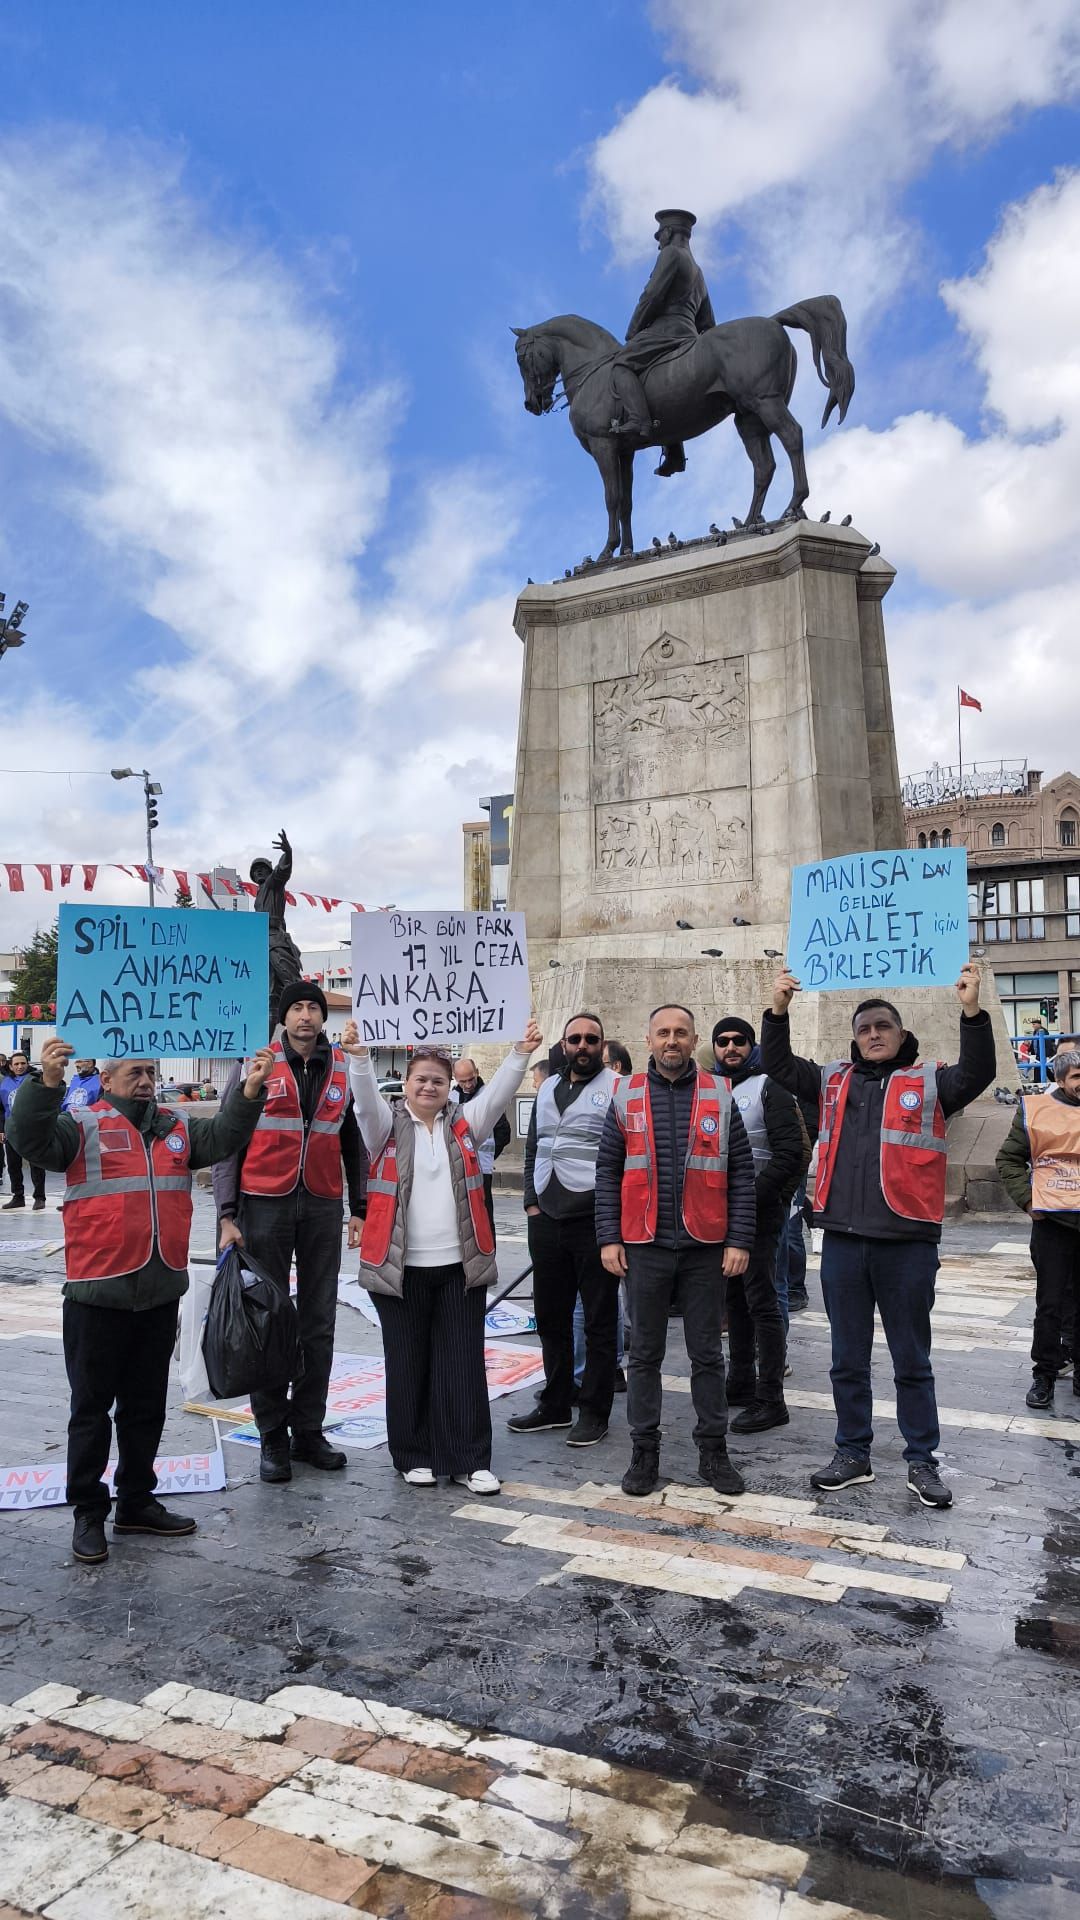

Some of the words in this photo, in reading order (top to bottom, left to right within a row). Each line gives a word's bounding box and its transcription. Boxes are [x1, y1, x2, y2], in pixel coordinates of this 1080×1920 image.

[948, 771, 1029, 791] BANKASI
[389, 914, 428, 938] BİR
[436, 916, 466, 937] GÜN
[476, 916, 514, 937] FARK
[804, 911, 923, 952] ADALET
[113, 953, 252, 986] ANKARA'YA
[402, 943, 427, 971] 17
[440, 945, 463, 967] YIL
[474, 940, 524, 967] CEZA
[804, 942, 936, 986] BİRLEŞTİK
[356, 971, 489, 1008] ANKARA
[61, 989, 203, 1027] ADALET
[362, 1018, 401, 1042] DUY
[412, 999, 505, 1040] SESİMİZİ
[102, 1024, 248, 1058] BURADAYIZ!
